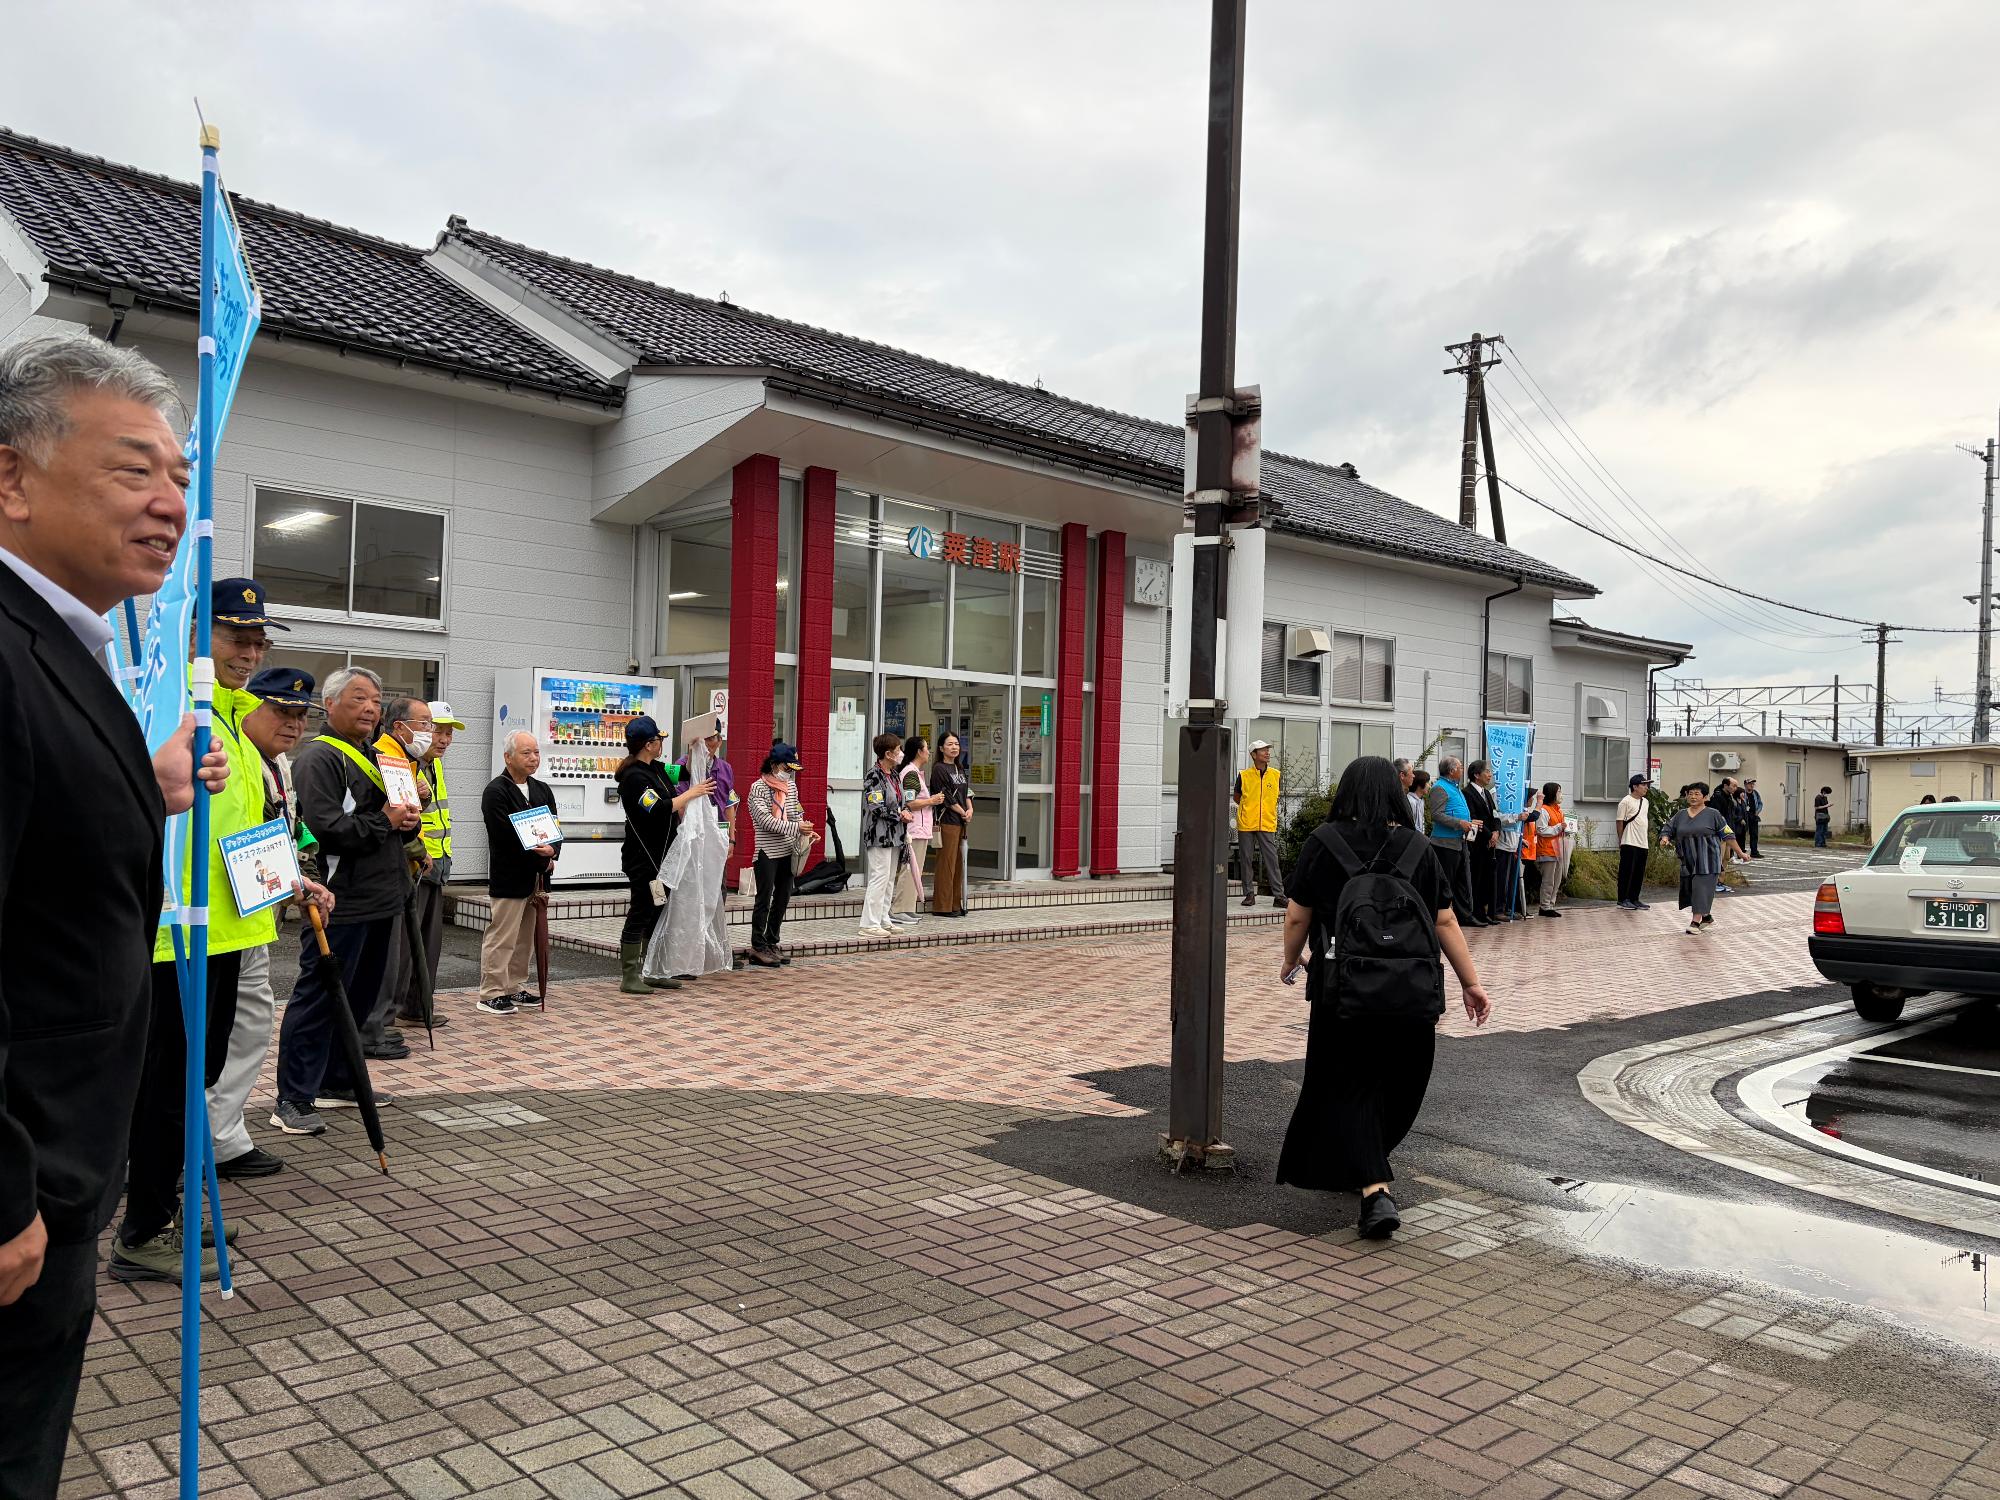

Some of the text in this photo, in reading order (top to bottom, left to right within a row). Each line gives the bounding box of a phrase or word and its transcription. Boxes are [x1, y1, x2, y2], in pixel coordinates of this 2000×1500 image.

[943, 531, 1020, 573] 粟津駅
[1938, 911, 1985, 928] 31-18
